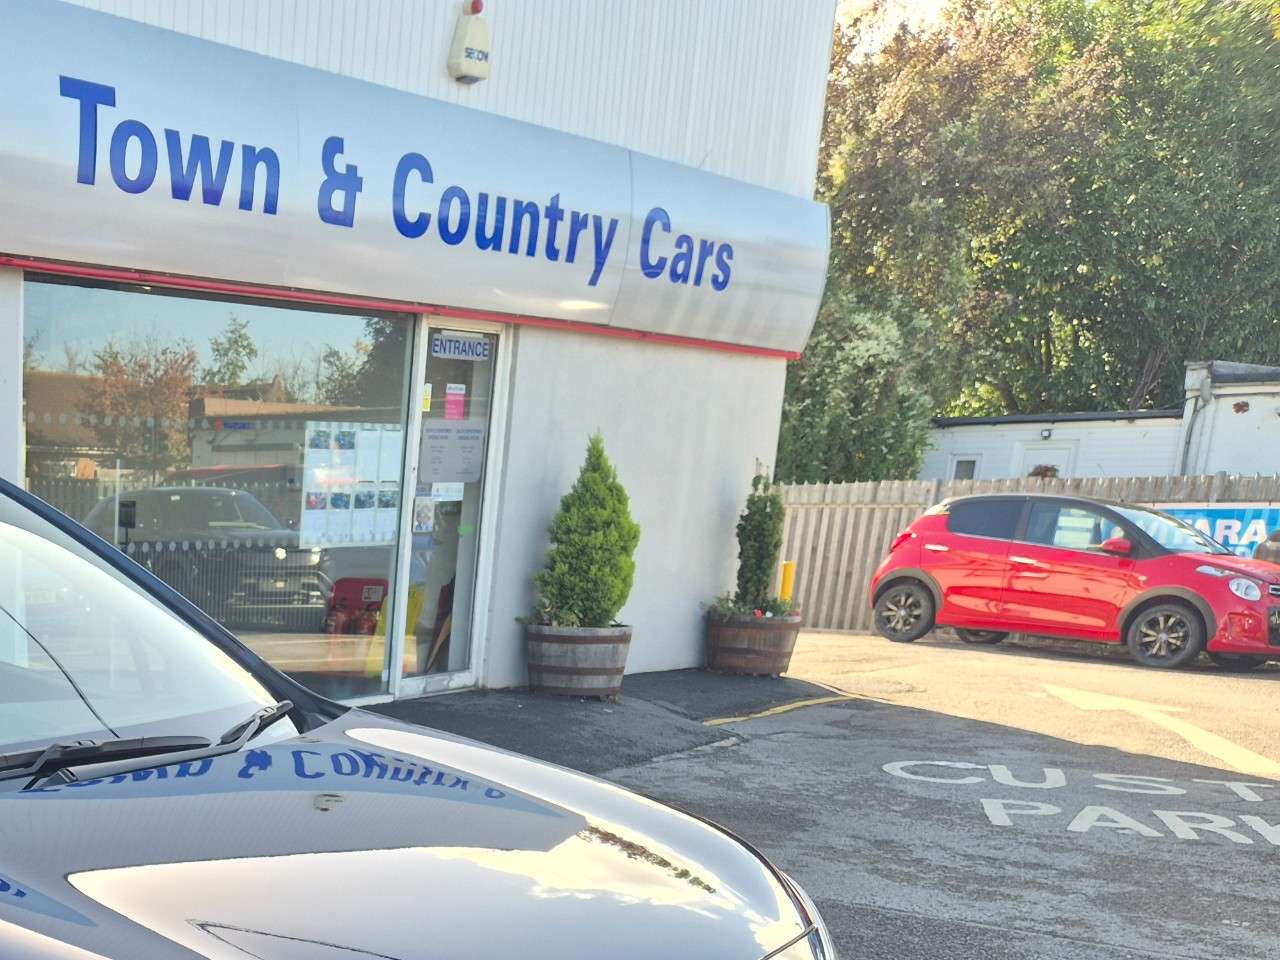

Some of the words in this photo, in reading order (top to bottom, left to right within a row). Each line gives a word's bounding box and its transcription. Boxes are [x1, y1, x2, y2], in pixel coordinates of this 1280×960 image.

[59, 75, 281, 216] Town
[318, 136, 363, 228] &
[392, 151, 619, 287] Country
[639, 207, 734, 291] Cars
[432, 337, 489, 358] ENTRANCE
